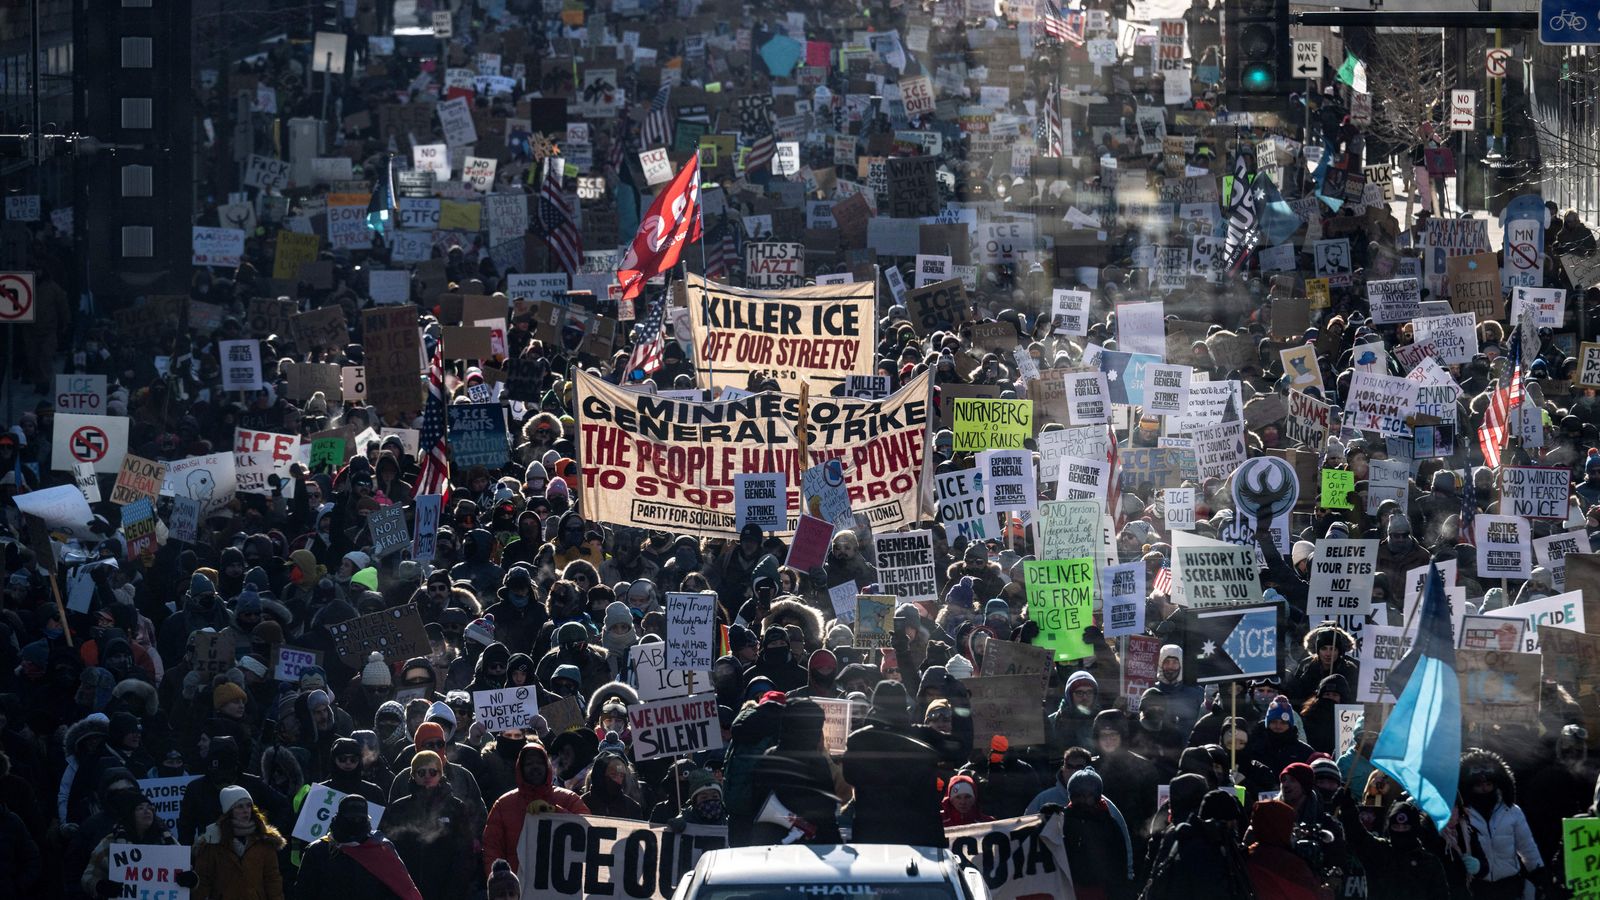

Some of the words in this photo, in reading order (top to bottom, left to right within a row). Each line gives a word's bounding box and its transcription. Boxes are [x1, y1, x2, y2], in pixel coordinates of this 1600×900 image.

[1161, 22, 1184, 36] NO
[1159, 45, 1183, 59] NO
[1298, 43, 1317, 52] ONE
[1297, 53, 1317, 62] WAY
[903, 84, 927, 99] ICE
[906, 97, 931, 111] OUT!
[1457, 95, 1469, 104] NO
[1453, 107, 1473, 115] STOPPING
[421, 149, 436, 157] NO
[642, 150, 665, 165] FUCK
[889, 161, 934, 178] WHAT
[1365, 167, 1391, 183] FUCK
[256, 171, 280, 186] ICE
[12, 197, 36, 206] DHS
[411, 200, 432, 208] ICE
[989, 225, 1019, 238] ICE
[1426, 221, 1448, 232] MAKE
[1450, 221, 1484, 233] AMERICA
[1429, 233, 1457, 247] GREAT
[1461, 233, 1484, 247] AGAIN
[1515, 230, 1533, 241] MN
[749, 244, 789, 258] THIS
[792, 244, 805, 258] IS
[751, 260, 796, 273] NAZI
[1456, 281, 1493, 298] PRETTI
[913, 285, 960, 313] ICE
[921, 303, 970, 328] OUT
[1459, 300, 1494, 316] GOOD
[702, 296, 802, 334] KILLER
[813, 305, 859, 336] ICE
[1414, 315, 1474, 331] IMMIGRANTS
[387, 331, 414, 351] ICE
[1432, 330, 1455, 338] MAKE
[702, 332, 733, 361] OFF
[737, 334, 773, 365] OUR
[776, 338, 860, 370] STREETS!
[1396, 342, 1438, 365] Justice
[1155, 370, 1171, 378] EXPAND
[1172, 371, 1182, 379] THE
[69, 379, 91, 392] ICE
[851, 376, 886, 390] KILLER
[1075, 378, 1099, 387] JUSTICE
[1154, 377, 1181, 388] GENERAL
[1075, 387, 1085, 396] FOR
[1085, 387, 1101, 395] ALEX
[1154, 392, 1178, 402] STRIKE!
[1355, 390, 1409, 406] HORCHATA
[58, 393, 100, 408] GTFO
[637, 393, 883, 424] MINNESOTA
[1290, 391, 1329, 428] SHAME
[1358, 402, 1398, 416] WARM
[453, 418, 495, 430] AGENTS
[583, 396, 788, 443] GENERAL
[801, 401, 926, 445] STRIKE
[1043, 427, 1103, 445] SILENCE
[1288, 415, 1323, 448] TRUMP
[237, 431, 294, 461] ICE
[955, 434, 986, 449] NAZIS
[991, 433, 1026, 449] RAUS!
[582, 424, 631, 467] THE
[637, 440, 735, 486] PEOPLE
[991, 457, 1010, 465] EXPAND
[1011, 457, 1022, 465] THE
[1205, 454, 1218, 464] LIKE
[1220, 451, 1237, 462] WHEN
[124, 458, 140, 472] NO
[142, 465, 165, 479] ONE
[992, 465, 1023, 477] GENERAL
[1069, 464, 1089, 473] EXPAND
[1089, 468, 1100, 476] THE
[118, 472, 155, 493] ILLEGAL
[744, 480, 763, 488] EXPAND
[764, 480, 777, 488] THE
[1069, 473, 1098, 486] GENERAL
[1326, 472, 1347, 481] ICE
[1502, 469, 1524, 484] COLD
[1527, 470, 1568, 485] WINTERS
[582, 467, 626, 489] TO
[635, 476, 734, 510] STOP
[745, 488, 776, 499] GENERAL
[938, 475, 968, 498] ICE
[995, 484, 1023, 495] STRIKE!
[1328, 482, 1346, 490] OUT
[1502, 486, 1524, 498] WARM
[1531, 486, 1567, 500] HEARTS
[1169, 492, 1189, 503] ICE
[637, 504, 667, 521] PARTY
[670, 507, 688, 524] FOR
[747, 505, 775, 516] STRIKE!
[1050, 504, 1067, 517] NO
[1069, 506, 1097, 516] person
[1514, 500, 1533, 515] NO
[1537, 501, 1559, 516] ICE
[371, 515, 382, 523] WE
[382, 509, 401, 518] ARE
[126, 525, 138, 538] ICE
[139, 519, 153, 534] OUT
[375, 519, 399, 534] NOT
[958, 519, 986, 540] MN
[1488, 522, 1517, 532] JUSTICE
[375, 528, 408, 554] AFRAID
[877, 535, 931, 552] GENERAL
[1487, 534, 1500, 544] FOR
[1501, 534, 1519, 544] ALEX
[1548, 538, 1576, 551] JUSTICE
[878, 550, 932, 568] STRIKE:
[1186, 551, 1236, 566] HISTORY
[1242, 551, 1253, 565] IS
[1326, 547, 1366, 557] BELIEVE
[879, 571, 897, 583] THE
[898, 568, 921, 581] PATH
[922, 566, 933, 579] TO
[1030, 563, 1091, 585] DELIVER
[1186, 568, 1254, 583] SCREAMING
[1317, 562, 1342, 574] YOUR
[1347, 562, 1372, 575] EYES
[1112, 570, 1135, 584] JUSTICE
[1331, 579, 1351, 590] NOT
[882, 581, 935, 597] JUSTICE
[1032, 590, 1048, 607] US
[1052, 586, 1091, 606] FROM
[1112, 584, 1122, 596] FOR
[1123, 583, 1136, 595] ALEX
[1194, 585, 1220, 598] ARE
[1224, 584, 1248, 599] YOU
[669, 598, 686, 618] Hey
[688, 597, 713, 614] Trump
[1316, 597, 1334, 608] THE
[1338, 597, 1359, 608] LIES
[1038, 608, 1080, 631] ICE
[1238, 626, 1277, 659] ICE
[281, 651, 312, 663] GTFO
[658, 670, 699, 690] ICE
[490, 693, 504, 705] NO
[479, 703, 524, 718] JUSTICE
[631, 709, 653, 729] WE
[655, 705, 682, 725] WILL
[683, 702, 702, 720] NOT
[704, 700, 718, 718] BE
[642, 721, 710, 757] SILENT
[114, 848, 142, 867] NO
[534, 819, 618, 895] ICE
